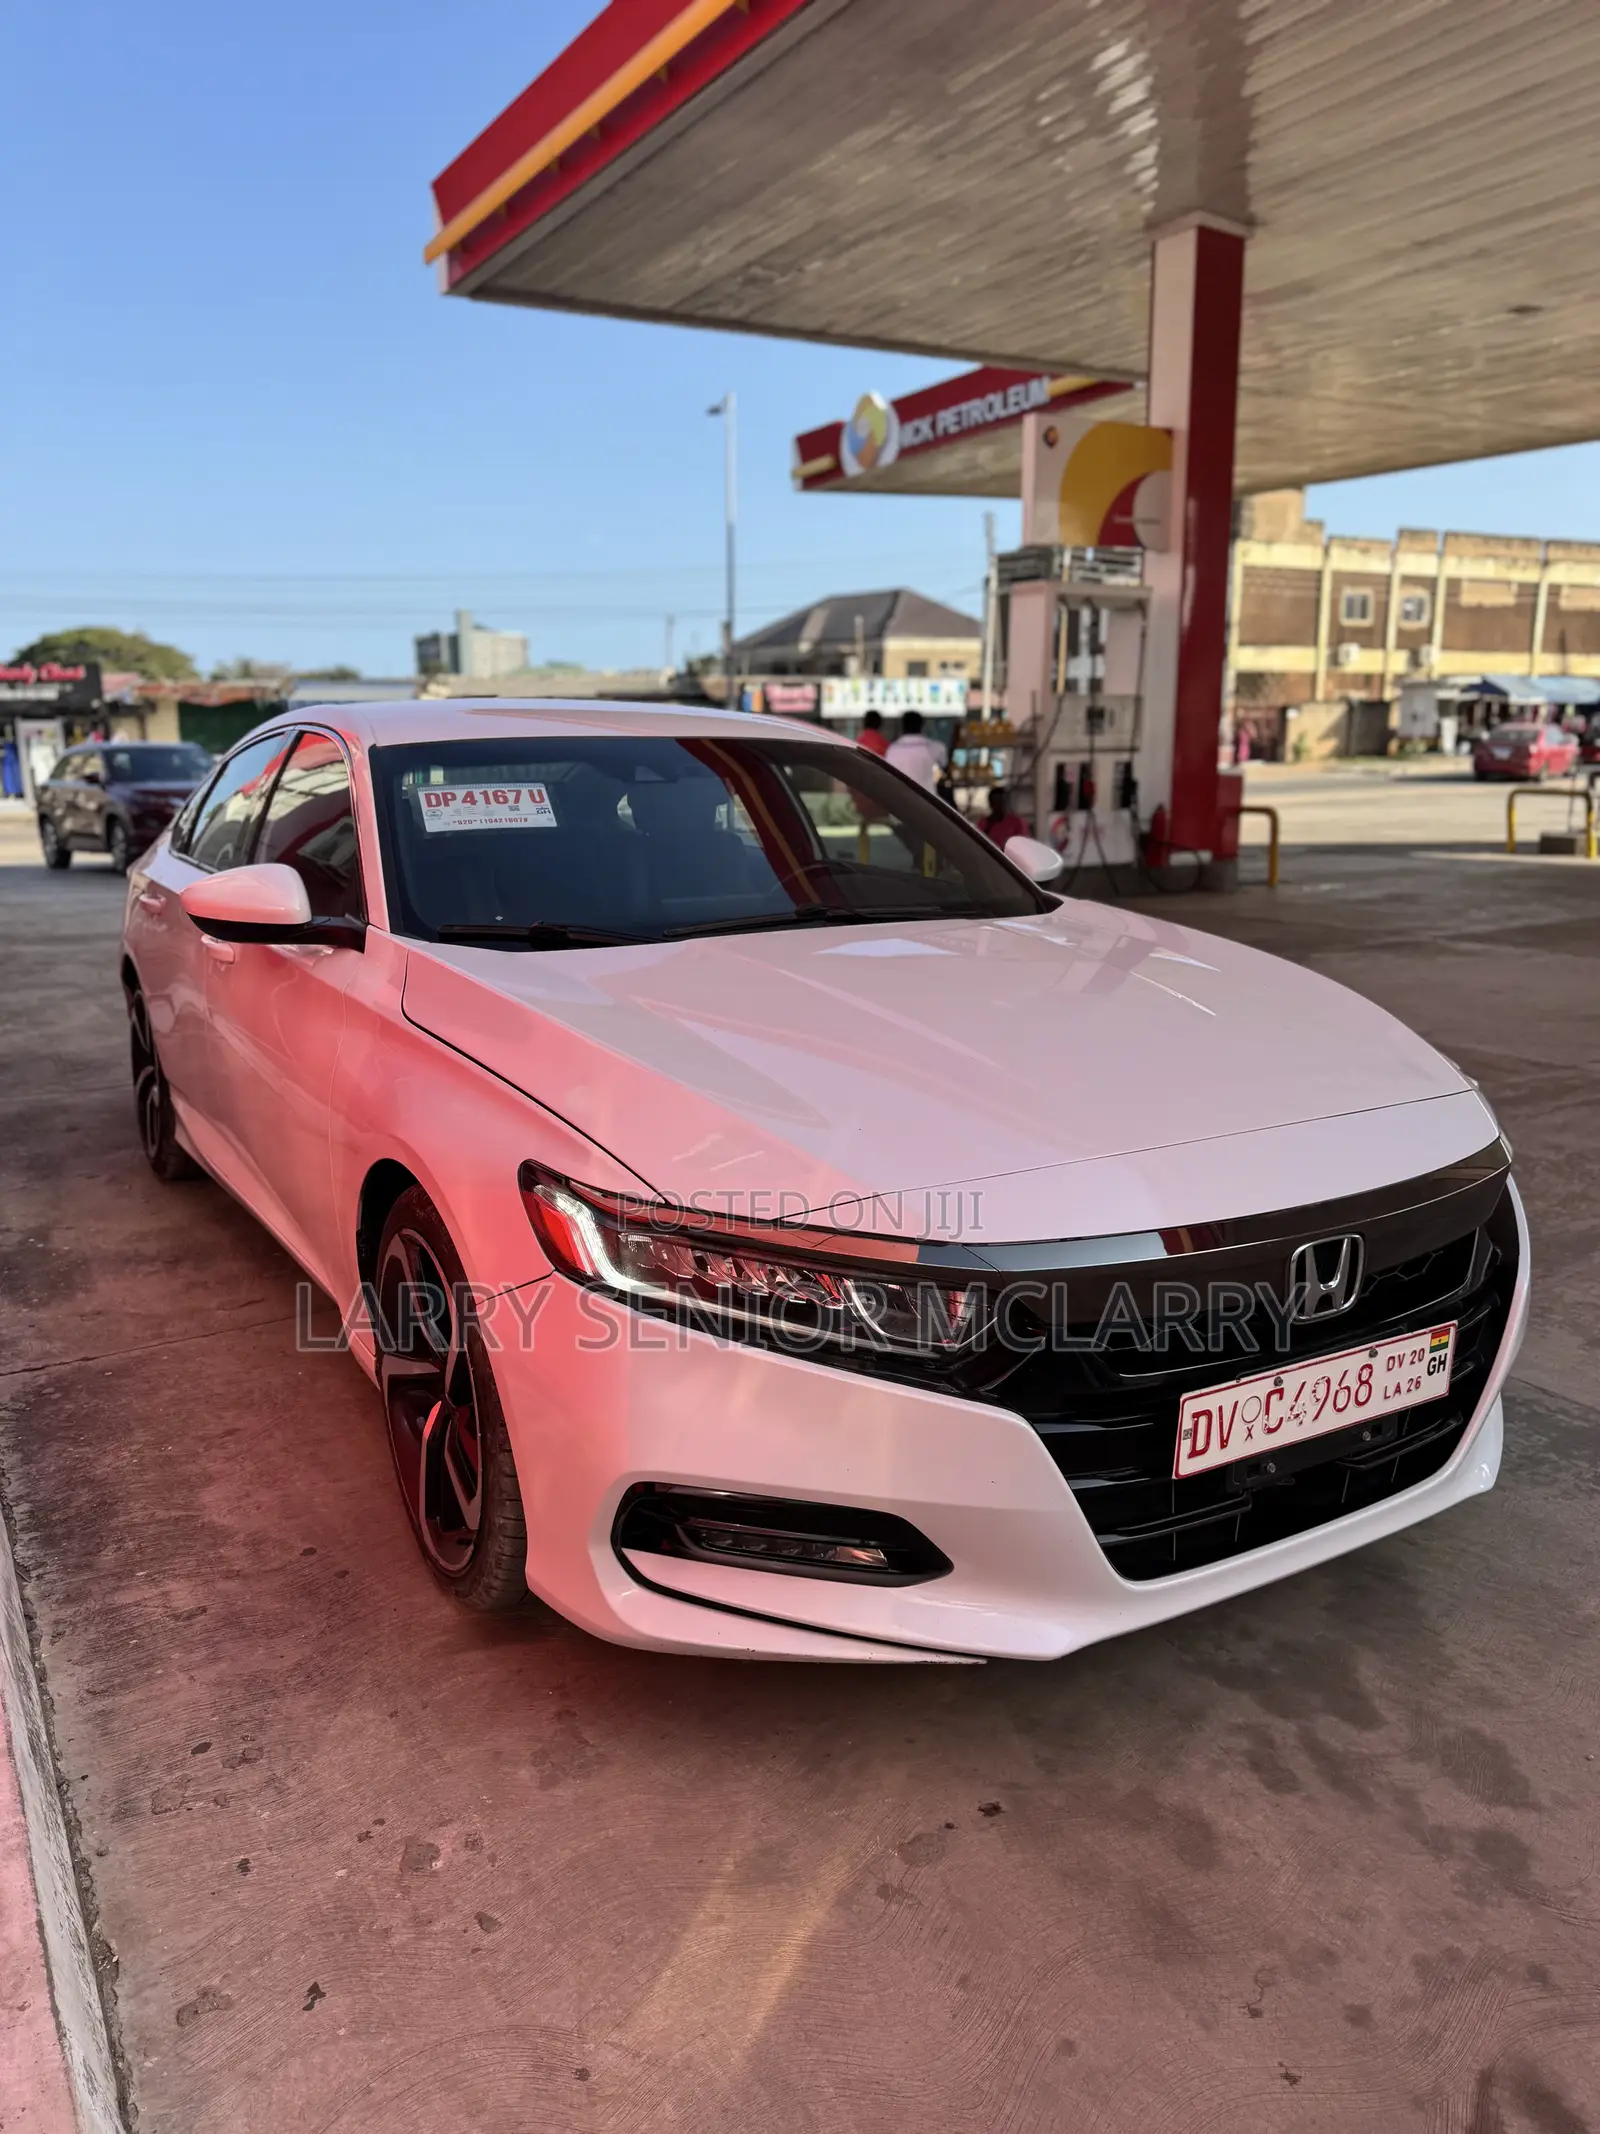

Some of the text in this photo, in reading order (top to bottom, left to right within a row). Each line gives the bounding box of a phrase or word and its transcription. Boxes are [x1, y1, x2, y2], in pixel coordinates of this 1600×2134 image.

[936, 374, 1050, 436] PETROLEUM
[424, 789, 546, 808] DP 4167 U
[1387, 1347, 1425, 1372] DV 20
[1426, 1352, 1447, 1377] GH
[1383, 1375, 1422, 1400] LA 26
[1187, 1400, 1239, 1459] DV
